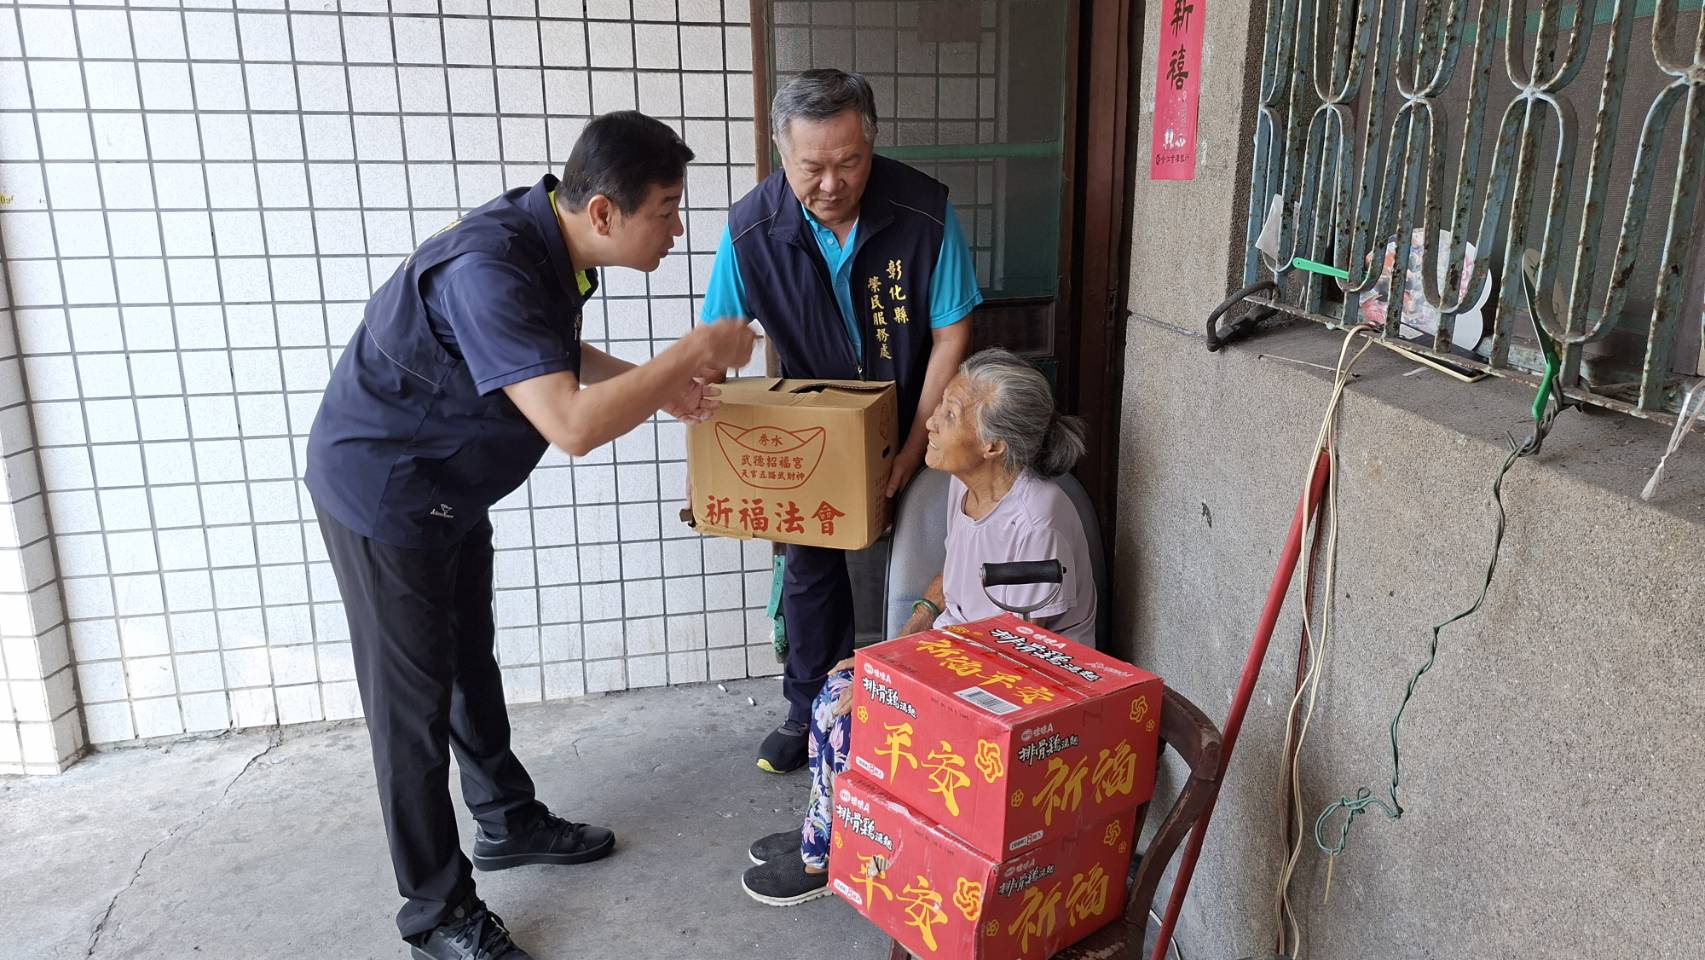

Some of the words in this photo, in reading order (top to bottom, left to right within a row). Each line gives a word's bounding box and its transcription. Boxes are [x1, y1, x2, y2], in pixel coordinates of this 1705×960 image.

[867, 275, 892, 359] 榮民服務處
[885, 259, 909, 324] 彰化縣
[741, 454, 804, 469] 武德招福宮
[706, 495, 846, 536] 祈福法會
[874, 721, 970, 817] 平安
[1031, 738, 1137, 826] 祈福
[1007, 861, 1110, 954] 祈福
